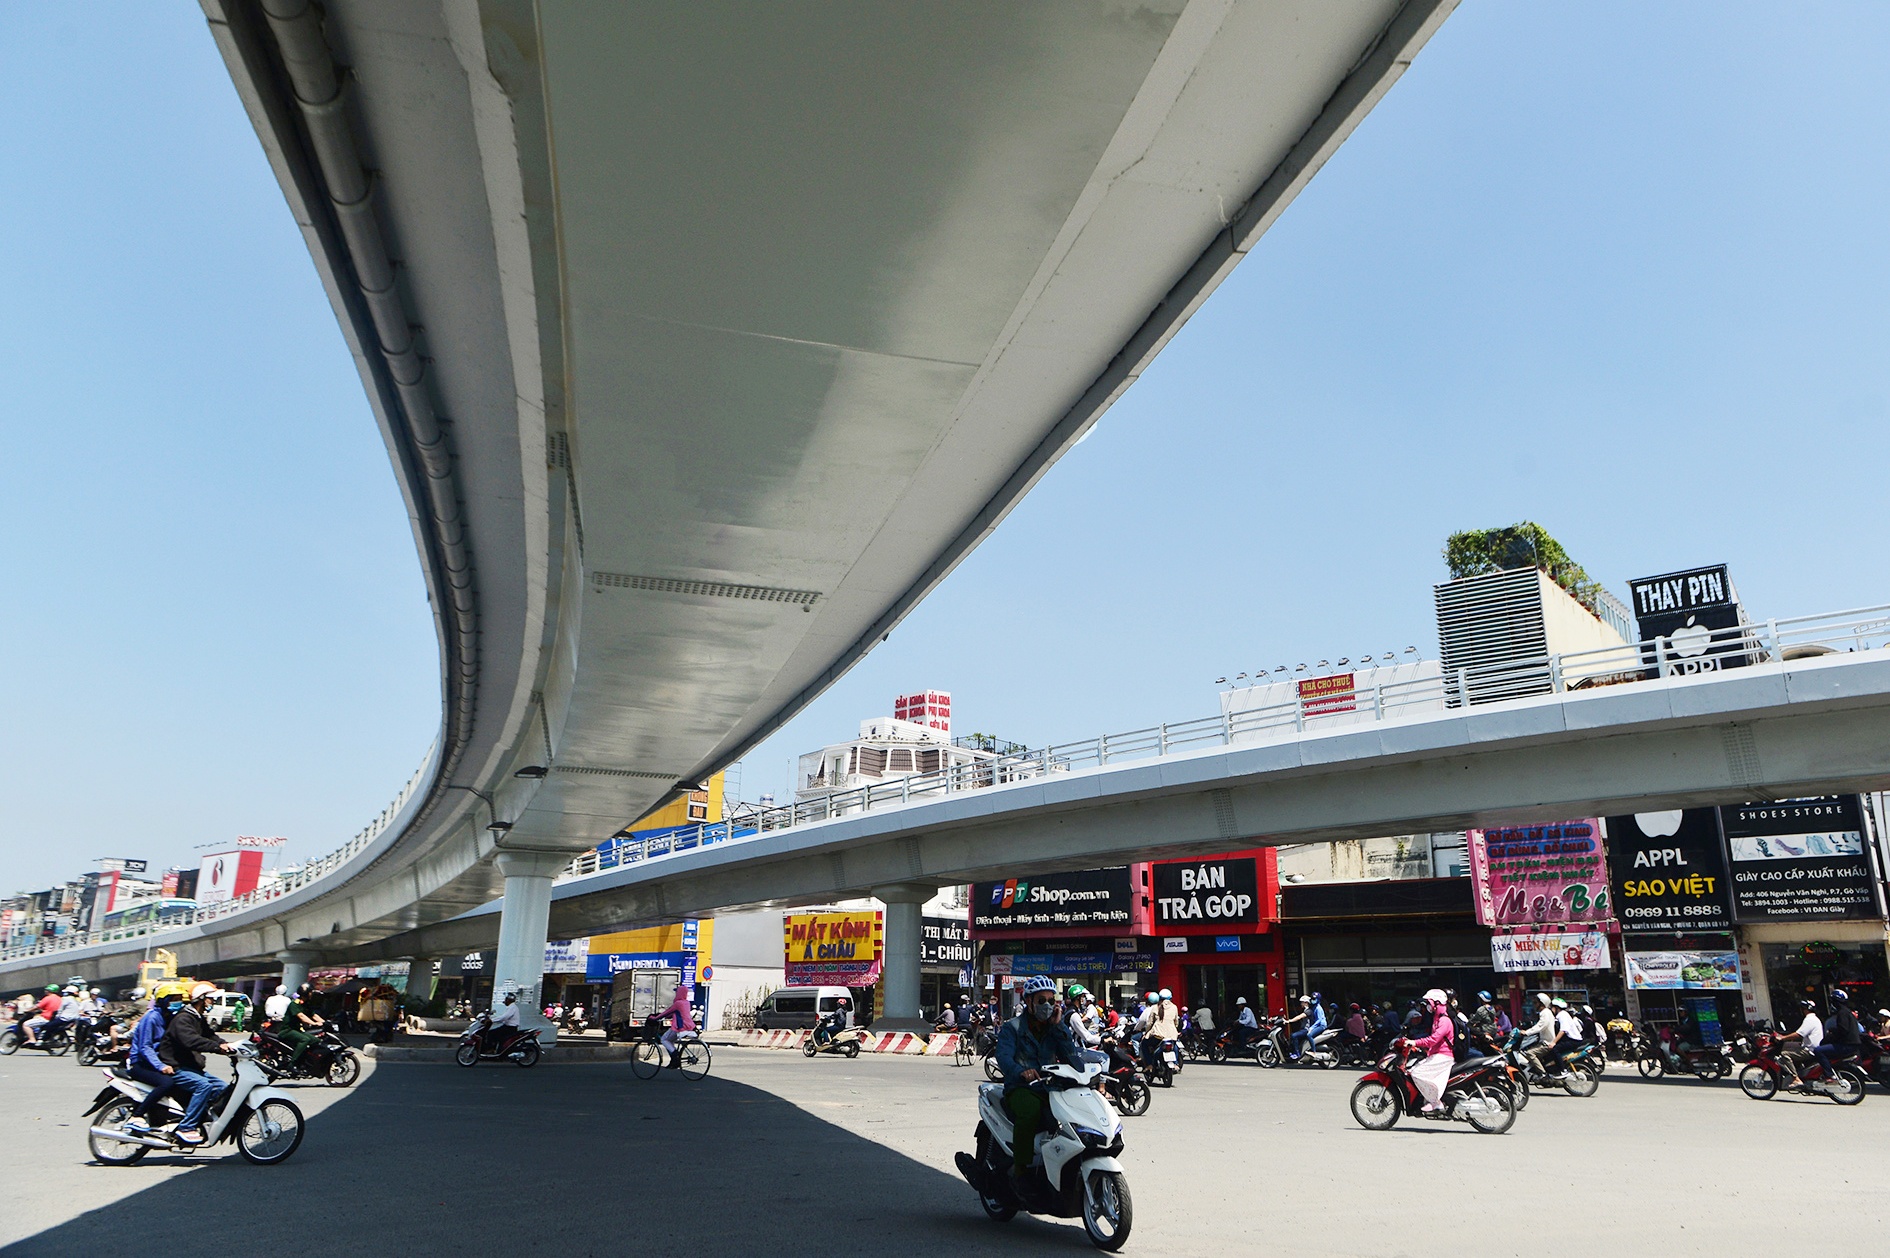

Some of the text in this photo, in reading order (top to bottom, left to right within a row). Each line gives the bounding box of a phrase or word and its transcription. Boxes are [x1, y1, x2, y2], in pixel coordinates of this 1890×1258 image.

[1636, 572, 1724, 613] THAY PIN
[1302, 674, 1351, 691] NHÀ CHO THUÊ
[1740, 806, 1843, 821] SHOES STORE
[1633, 847, 1688, 869] APPL
[1181, 864, 1225, 891] BÁN
[1735, 870, 1759, 882] GIÀY
[1761, 871, 1783, 881] CAO
[1785, 867, 1805, 880] CẤP
[1807, 866, 1834, 879] XUẤT
[1623, 873, 1716, 899] SAO VIỆT
[1740, 891, 1756, 899] Add:
[1756, 890, 1769, 898] 406
[1769, 888, 1796, 899] Nguyễn
[1796, 888, 1810, 897] Văn
[1843, 886, 1854, 895] Gò
[1158, 890, 1252, 920] TRẢ GÓP
[1497, 882, 1609, 918] Mẹ & Bé
[1741, 900, 1754, 908] Tel:
[1793, 897, 1819, 906] Hotline
[975, 915, 992, 927] Điện
[993, 914, 1012, 926] thoại
[1016, 913, 1032, 925] Máy
[1054, 911, 1071, 923] Máy
[1110, 910, 1128, 922] kiện
[1625, 905, 1723, 918] 0969 11 8888
[1767, 907, 1799, 915] Facebook
[792, 916, 871, 941] MẮT KÍNH
[924, 926, 941, 941] THỊ
[942, 922, 962, 940] MẮT
[803, 939, 856, 960] Á CHÂU
[938, 943, 972, 961] CHÂU
[1515, 936, 1541, 952] MIỄN
[1543, 936, 1561, 951] PHÍ
[633, 958, 670, 969] DENTAL
[1505, 957, 1530, 968] HÌNH
[1548, 957, 1560, 966] VÍ
[1645, 962, 1677, 970] CHEVROLET
